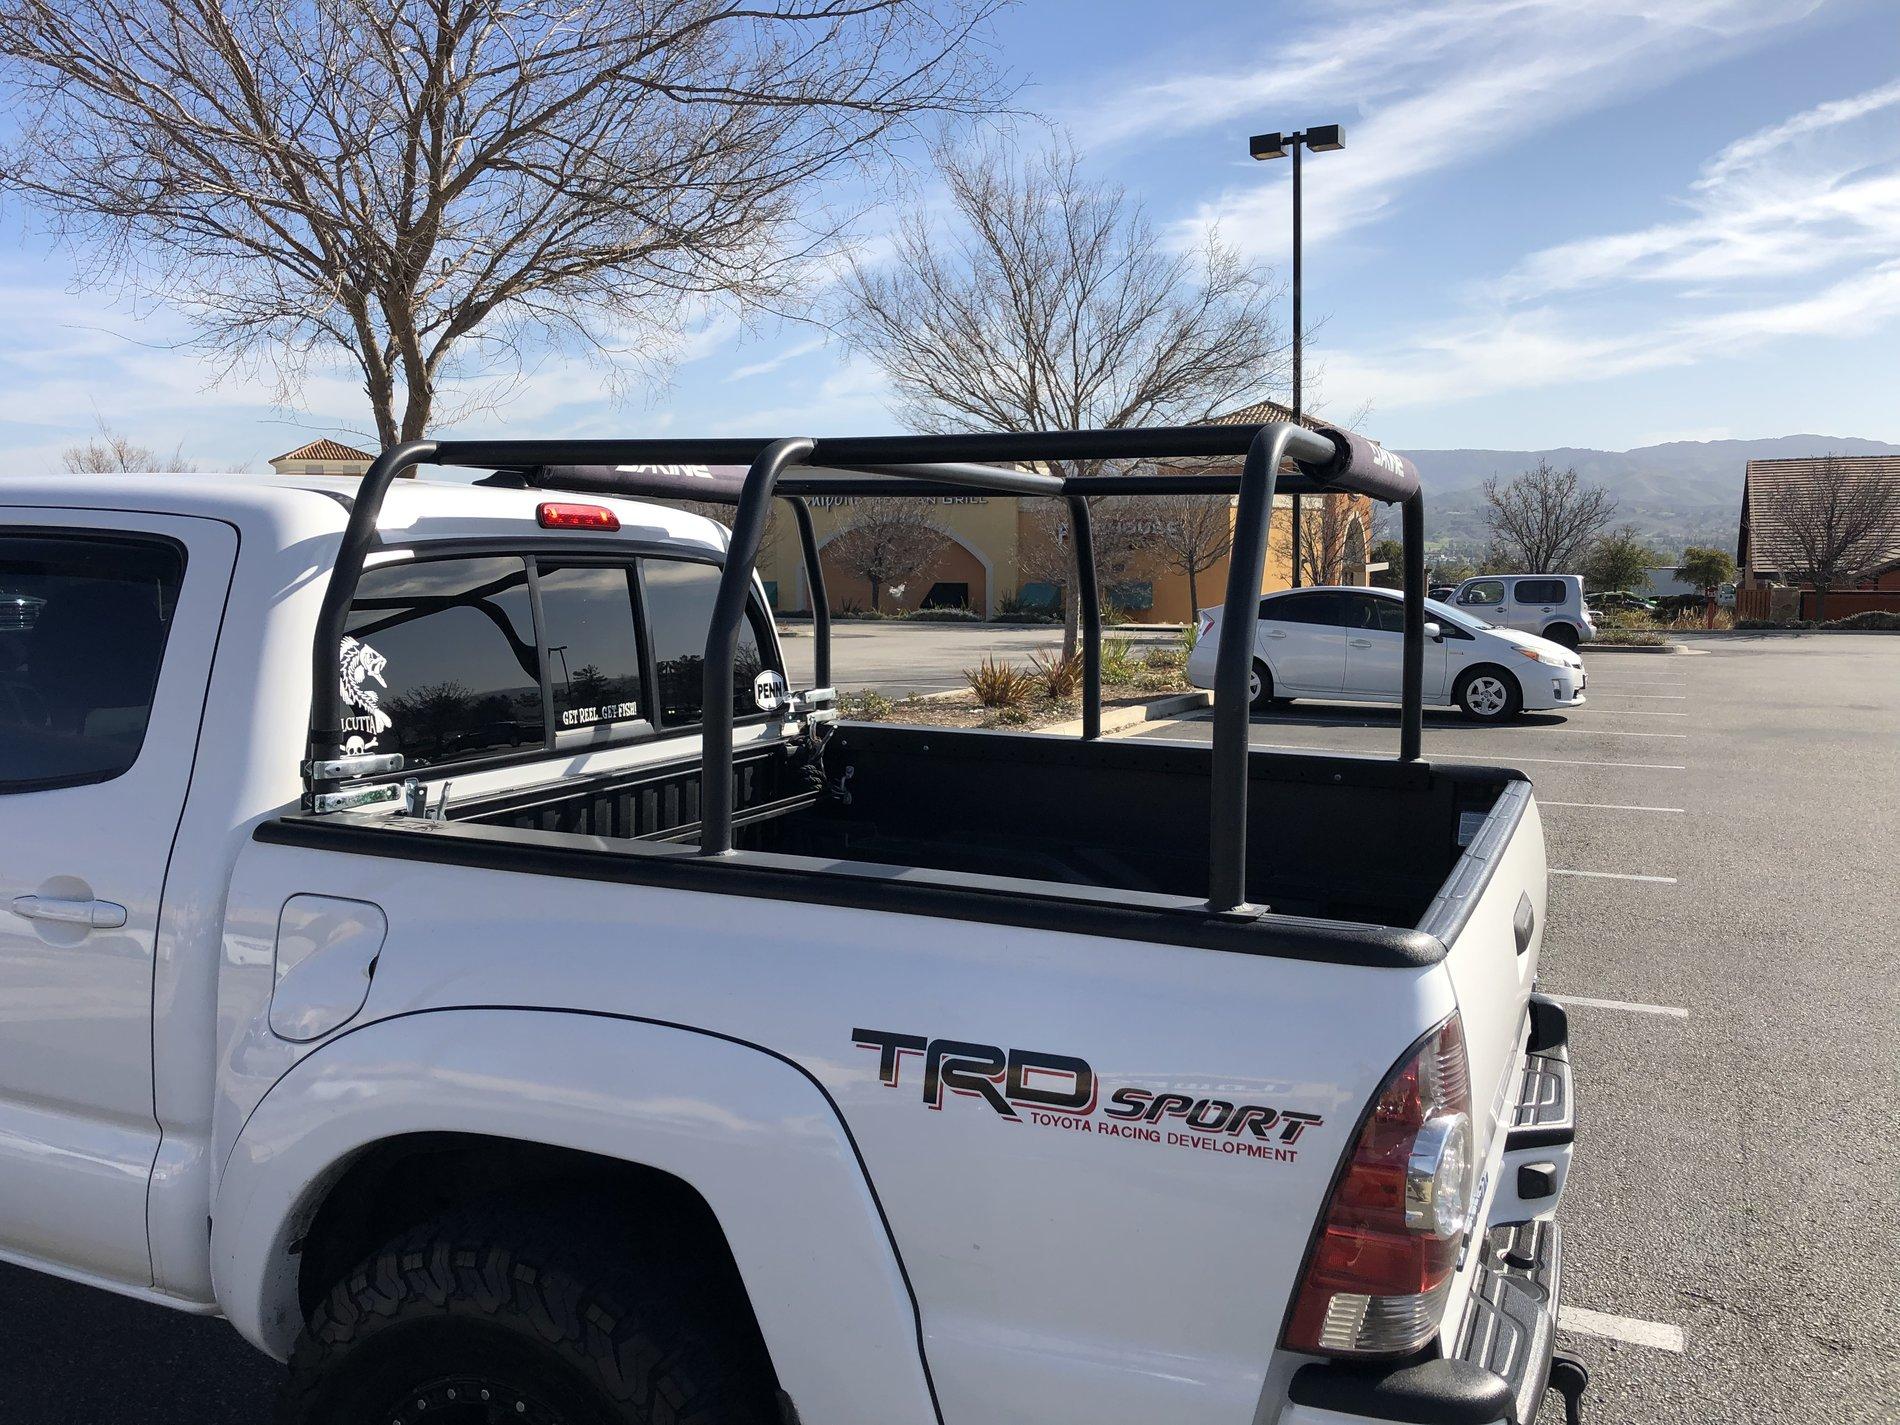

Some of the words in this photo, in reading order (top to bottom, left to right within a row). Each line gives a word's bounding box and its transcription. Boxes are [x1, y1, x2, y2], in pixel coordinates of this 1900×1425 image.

[757, 681, 783, 699] PENN
[340, 715, 377, 735] LCUTTA
[562, 710, 578, 725] GET
[851, 1027, 1099, 1123] TRD
[1103, 1087, 1324, 1145] SPORT
[1031, 1111, 1092, 1133] TOYOTA
[1098, 1121, 1161, 1143] RACING
[1167, 1132, 1298, 1163] DEVELOPMENT
